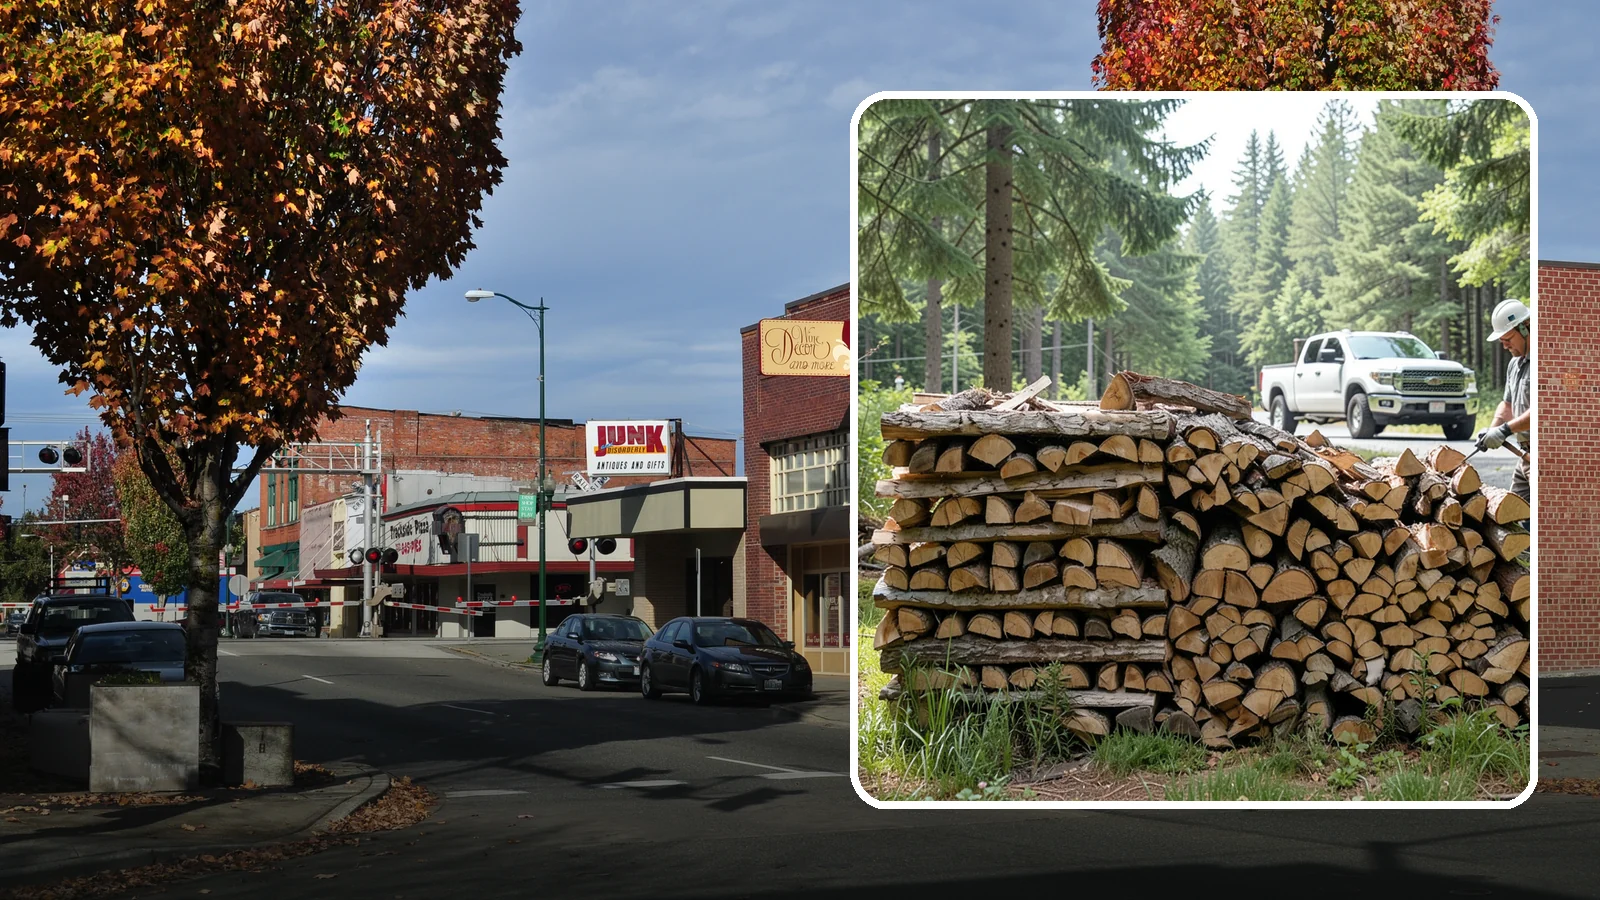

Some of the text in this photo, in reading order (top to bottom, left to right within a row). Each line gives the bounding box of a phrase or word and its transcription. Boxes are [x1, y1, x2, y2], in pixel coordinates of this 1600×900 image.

[595, 425, 665, 457] JUNK
[607, 446, 646, 454] DISORDERLY
[597, 460, 665, 470] ANTIQUES AND GIFTS
[414, 519, 429, 534] Pizza
